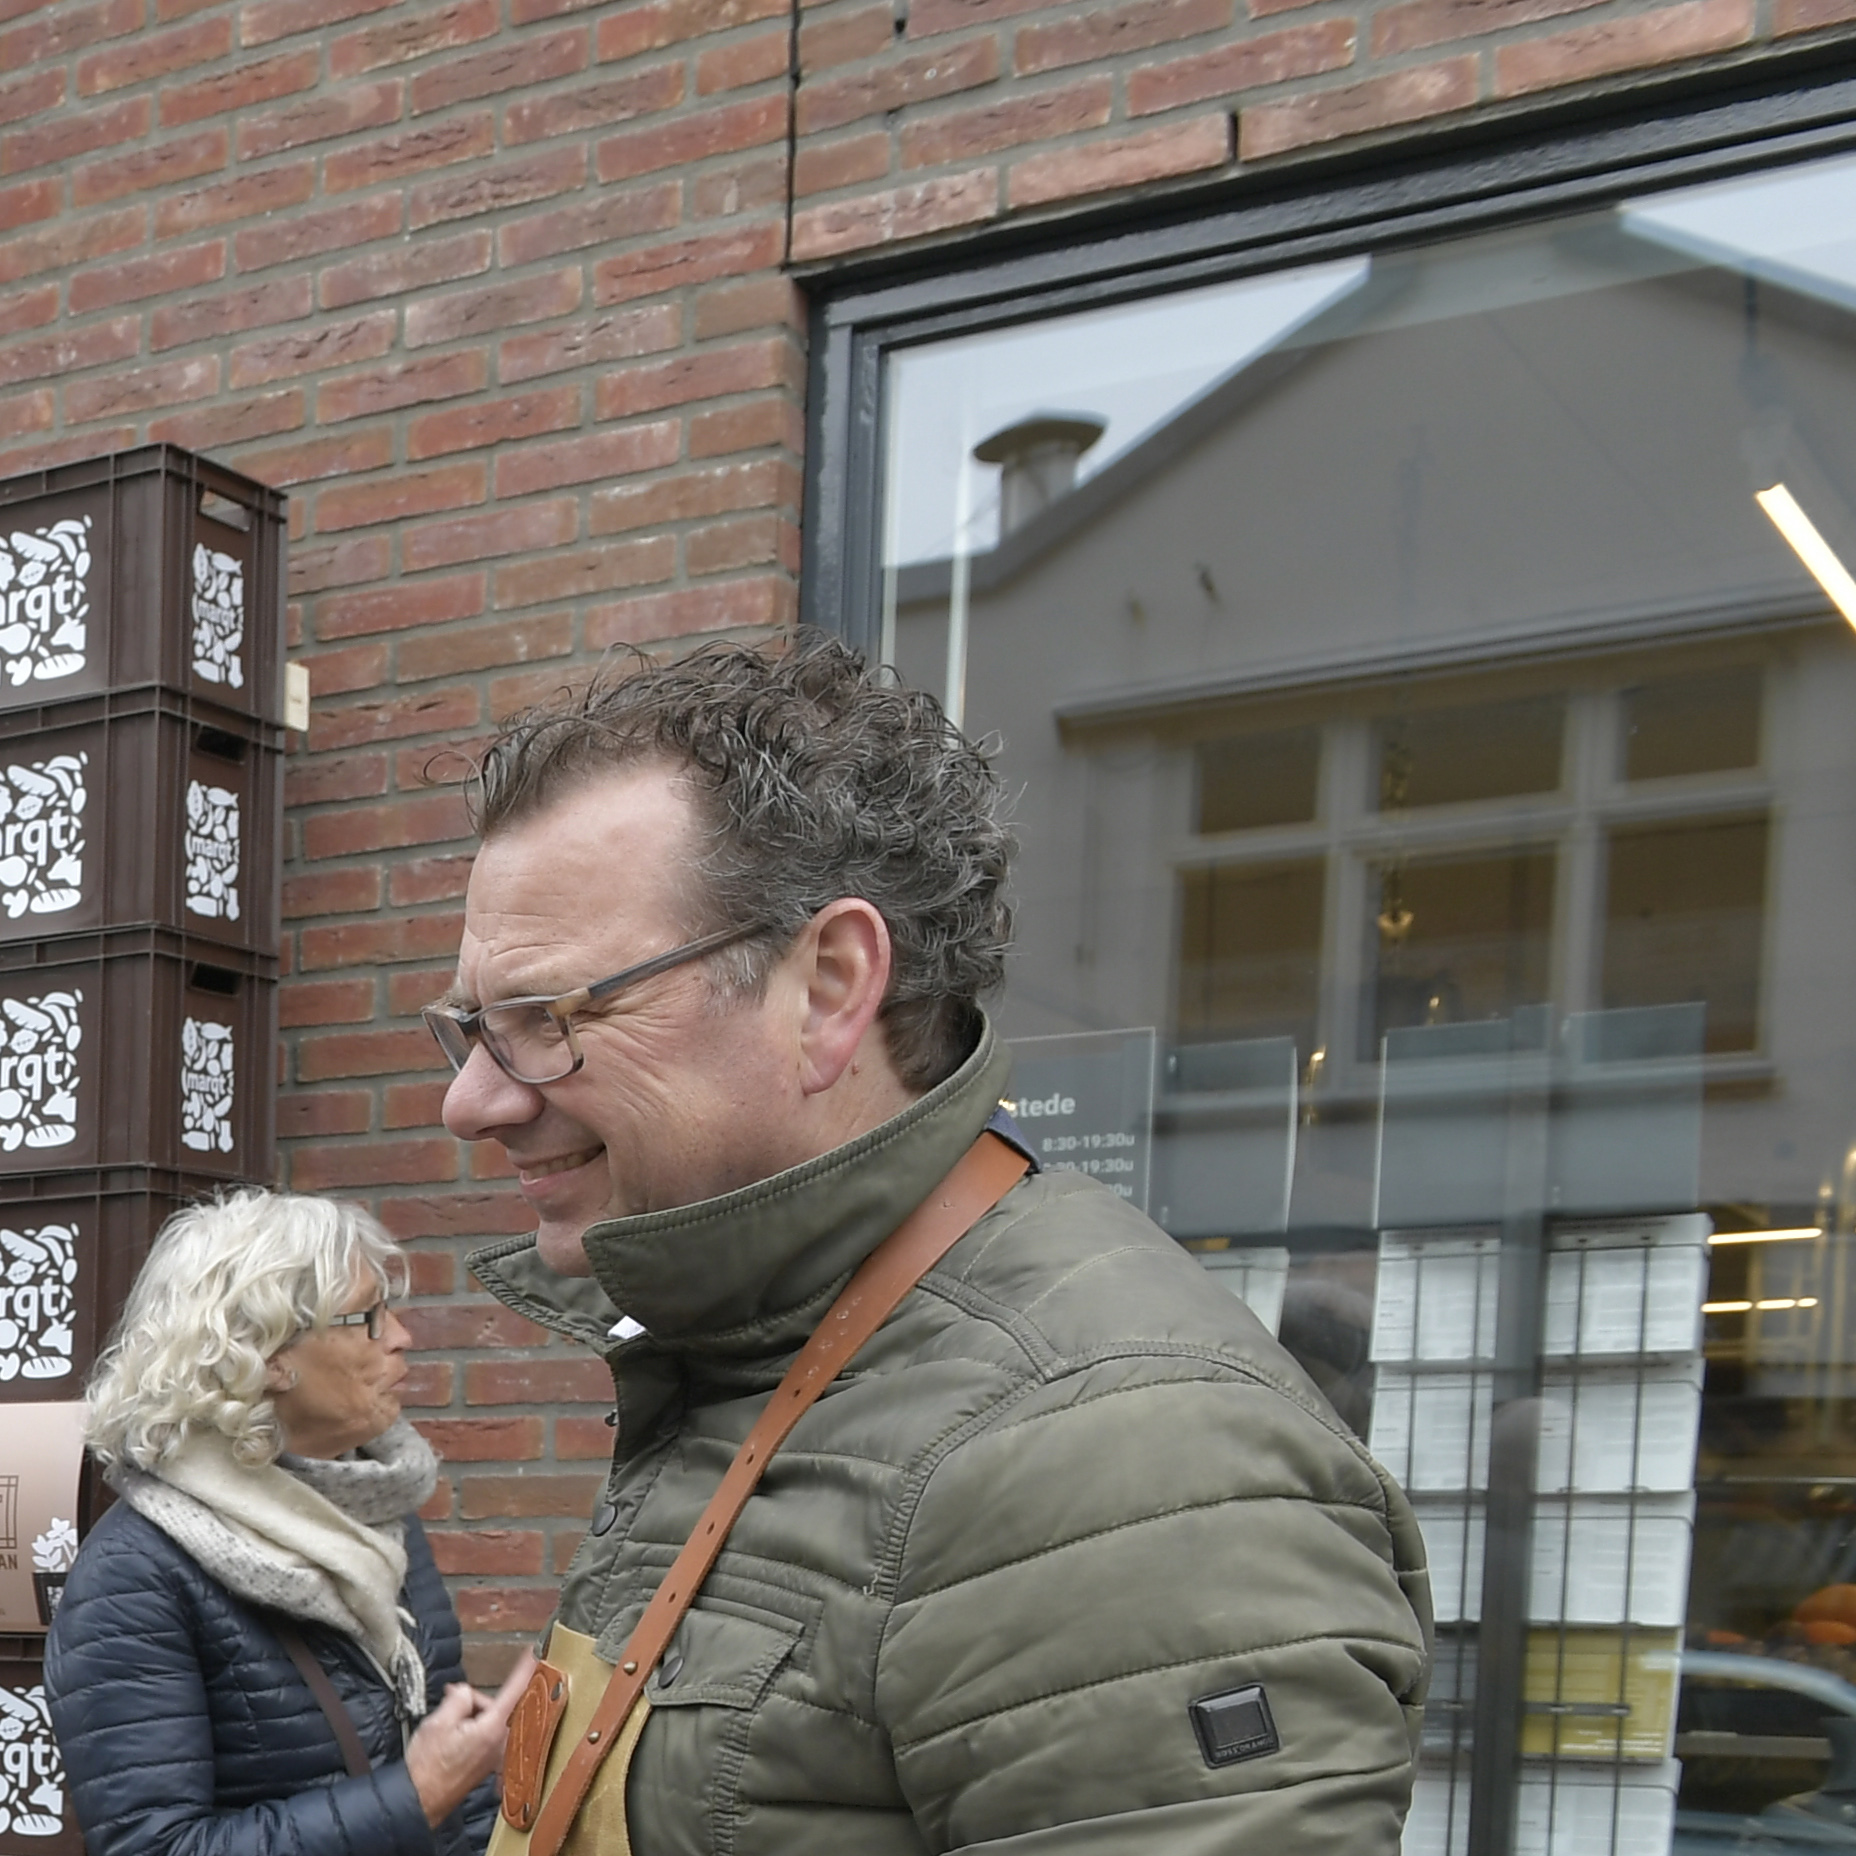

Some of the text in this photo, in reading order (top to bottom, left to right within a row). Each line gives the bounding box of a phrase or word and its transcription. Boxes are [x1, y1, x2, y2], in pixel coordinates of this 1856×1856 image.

[196, 598, 236, 631] marqt
[191, 834, 232, 863] marqt
[187, 1070, 227, 1095] marqt
